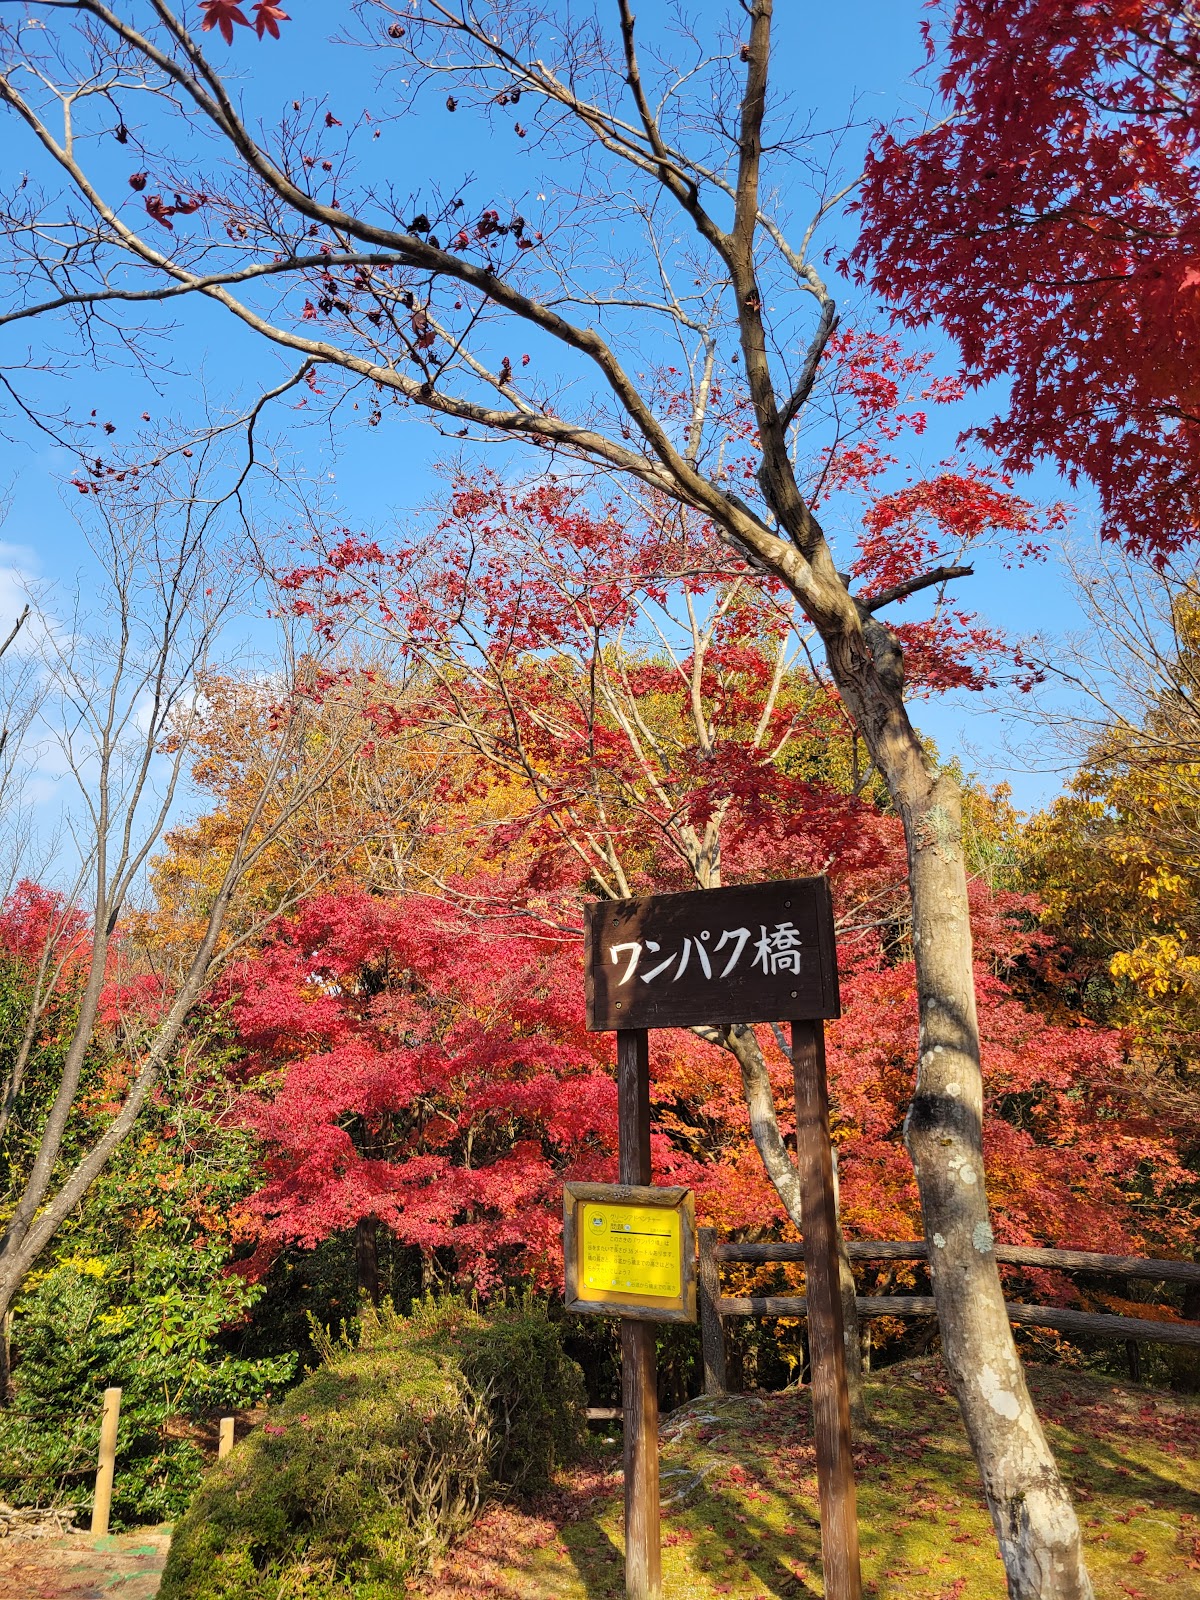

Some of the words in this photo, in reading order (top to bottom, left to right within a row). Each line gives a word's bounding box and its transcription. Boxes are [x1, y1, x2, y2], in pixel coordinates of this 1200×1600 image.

[609, 922, 802, 986] ワンパク橋
